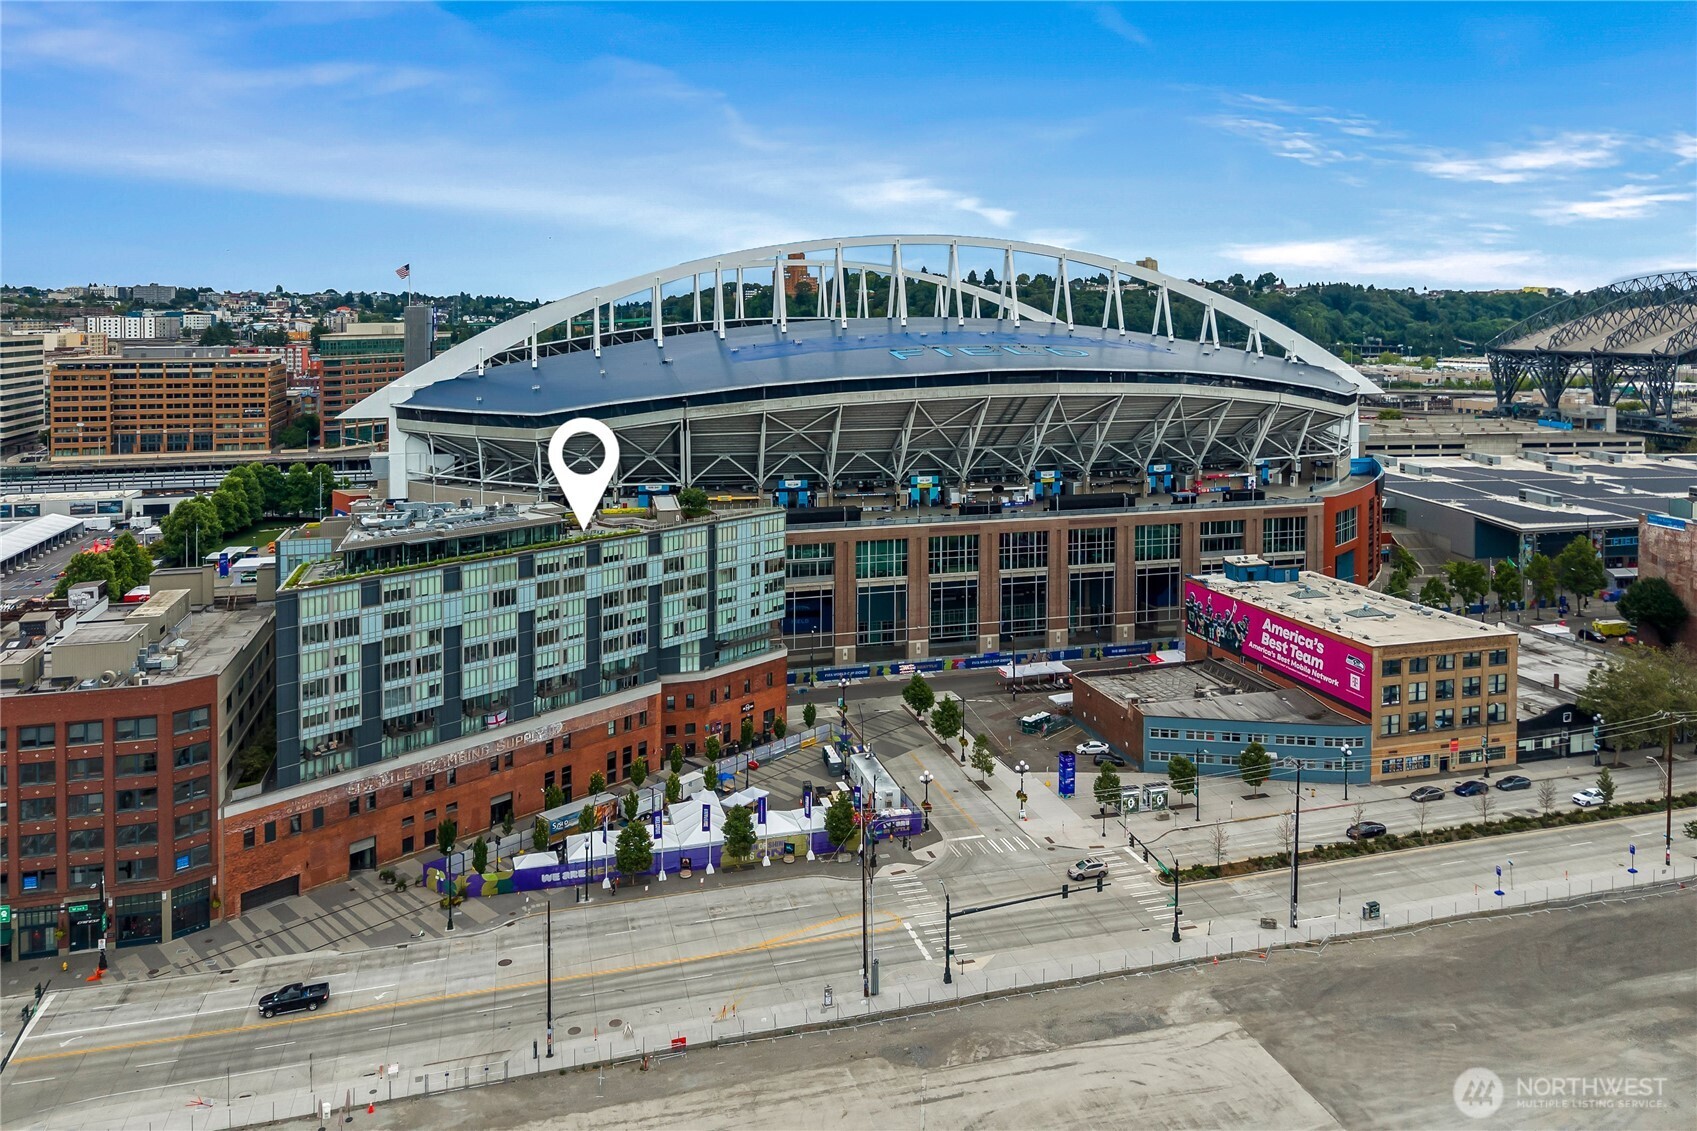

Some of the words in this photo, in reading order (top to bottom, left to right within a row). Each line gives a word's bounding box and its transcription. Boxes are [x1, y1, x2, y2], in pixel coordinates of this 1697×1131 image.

[889, 346, 1089, 360] FIELD
[1262, 618, 1324, 654] America's
[1261, 632, 1288, 654] Best
[1290, 643, 1324, 670] Team
[1248, 641, 1276, 658] America's
[1277, 653, 1290, 665] Best
[1290, 660, 1312, 675] Mobile
[1312, 669, 1340, 687] Network
[768, 840, 785, 849] SHIN
[542, 870, 560, 882] WE
[562, 868, 586, 880] ARE
